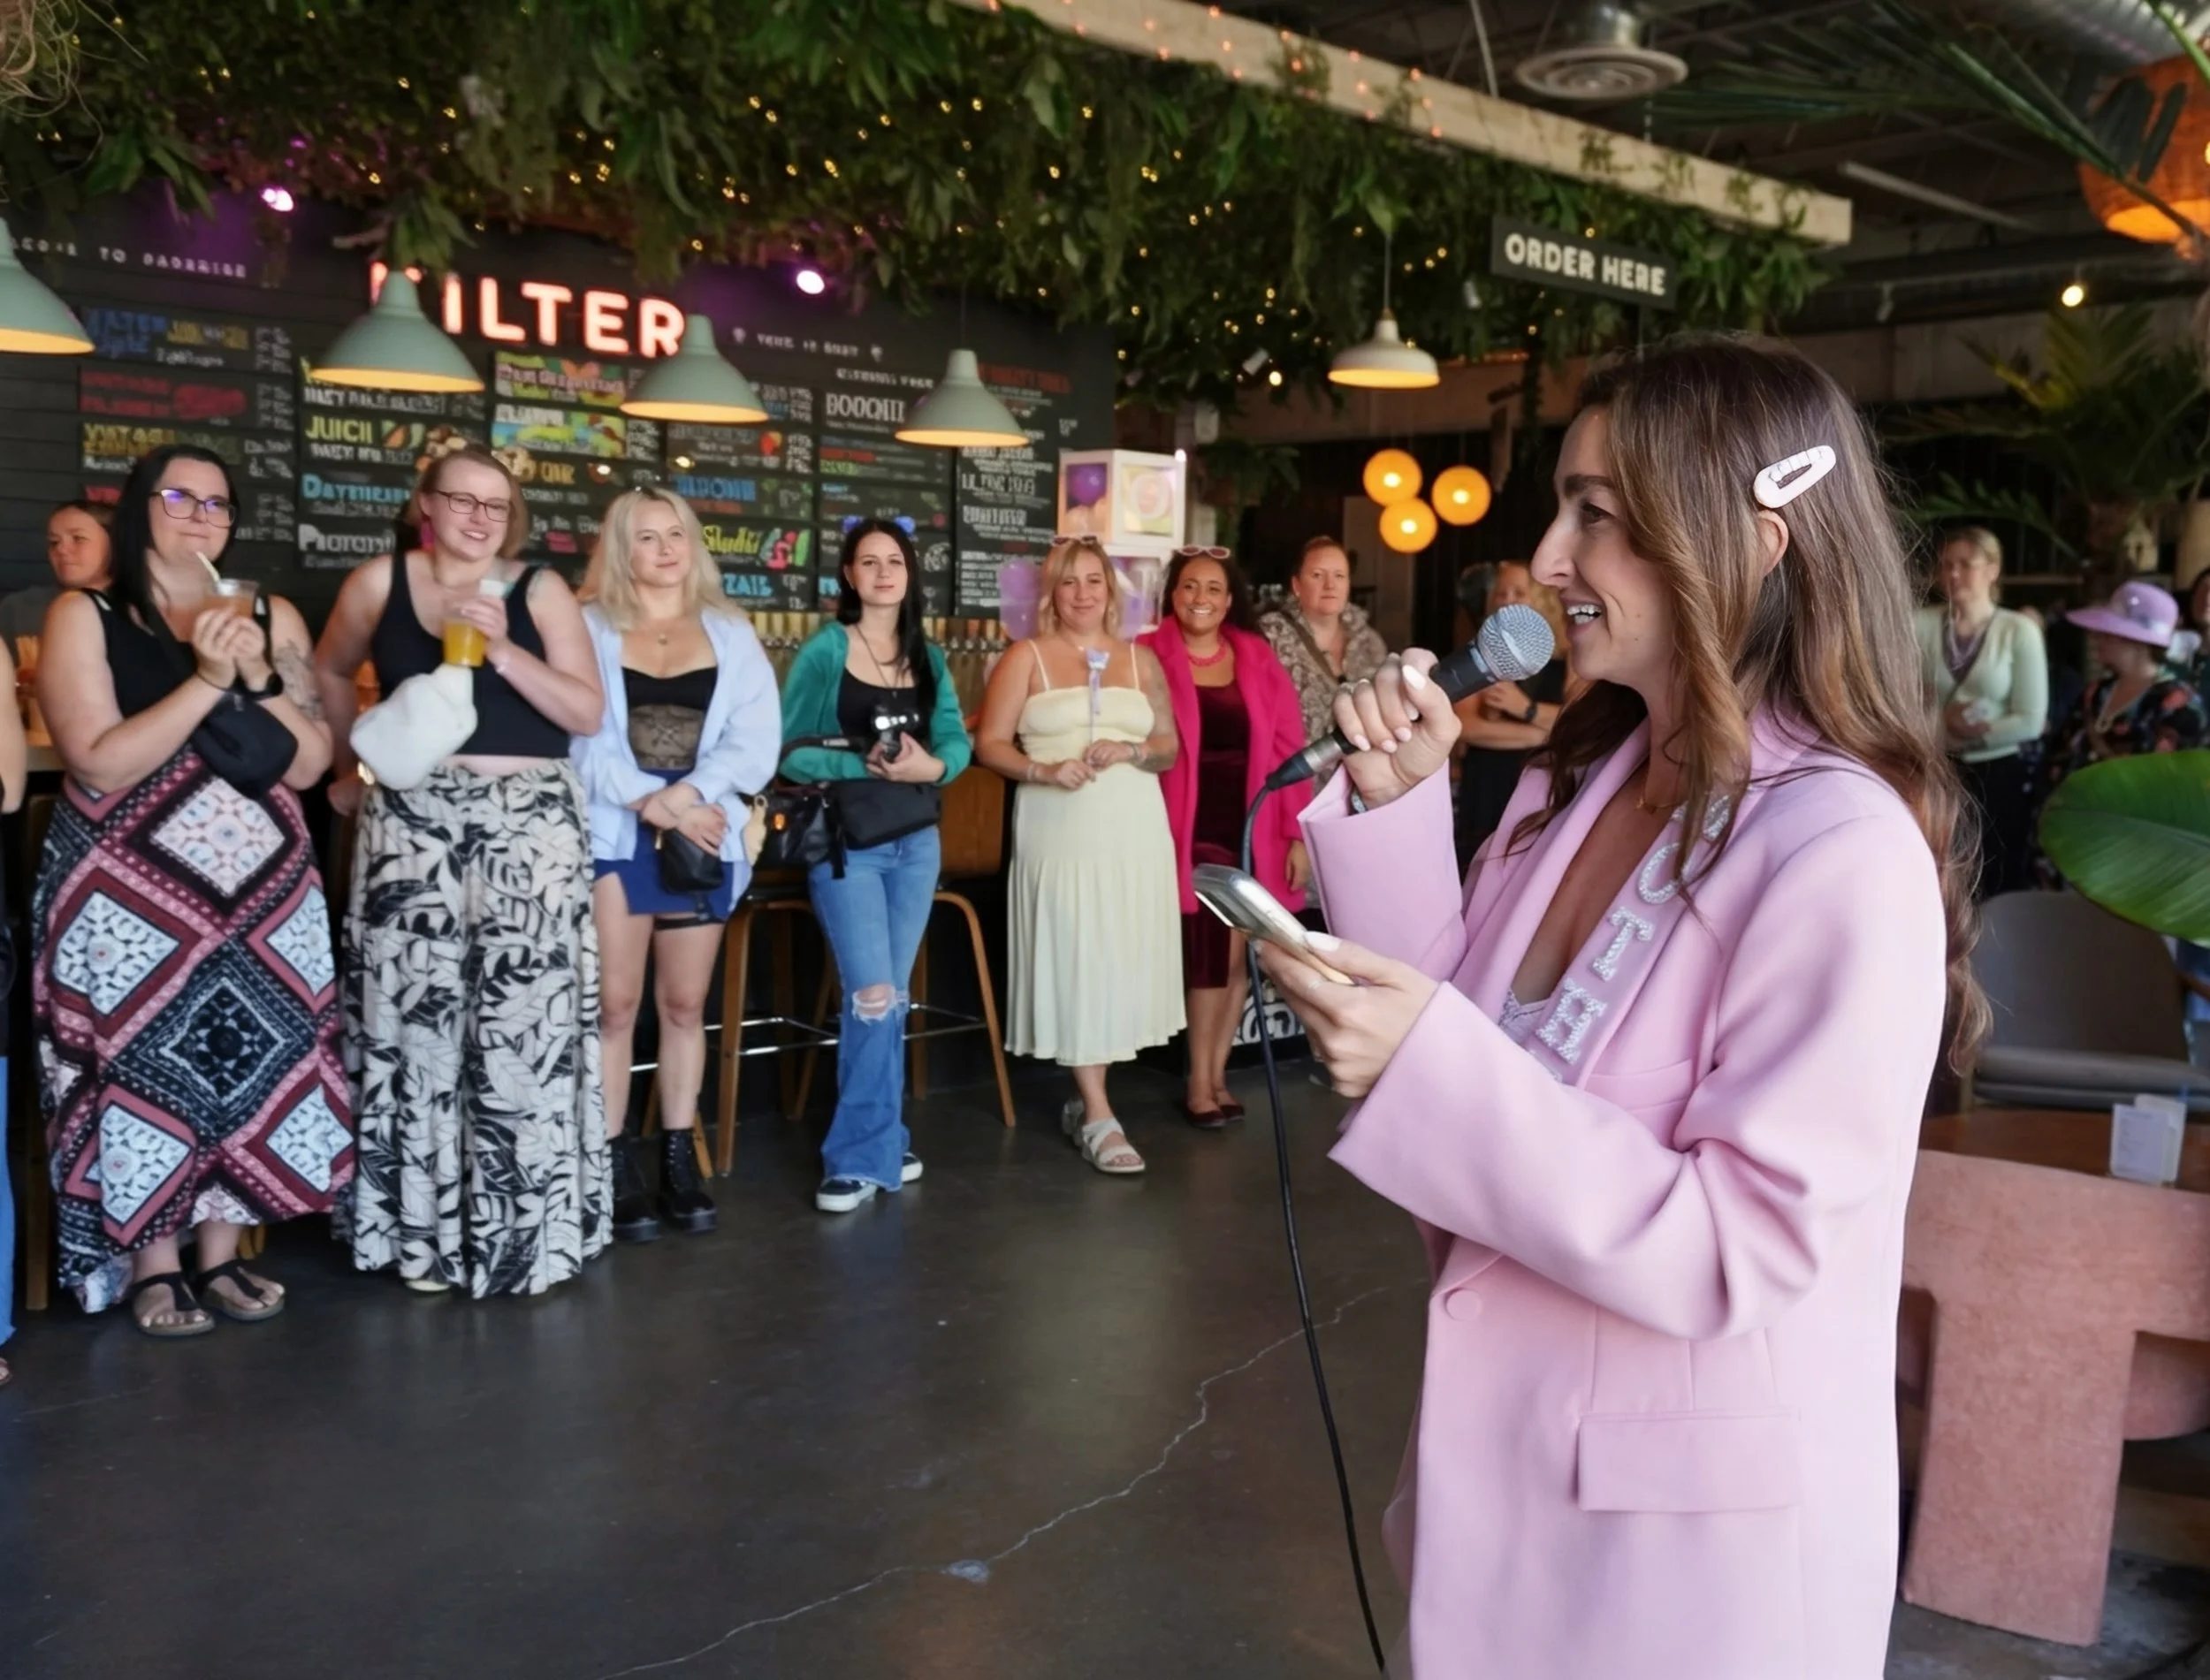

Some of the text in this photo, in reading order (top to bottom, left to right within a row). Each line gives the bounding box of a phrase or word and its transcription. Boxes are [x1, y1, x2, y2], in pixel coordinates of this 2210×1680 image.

[1505, 233, 1666, 296] ORDER HERE
[1533, 794, 1730, 1071] OTH
